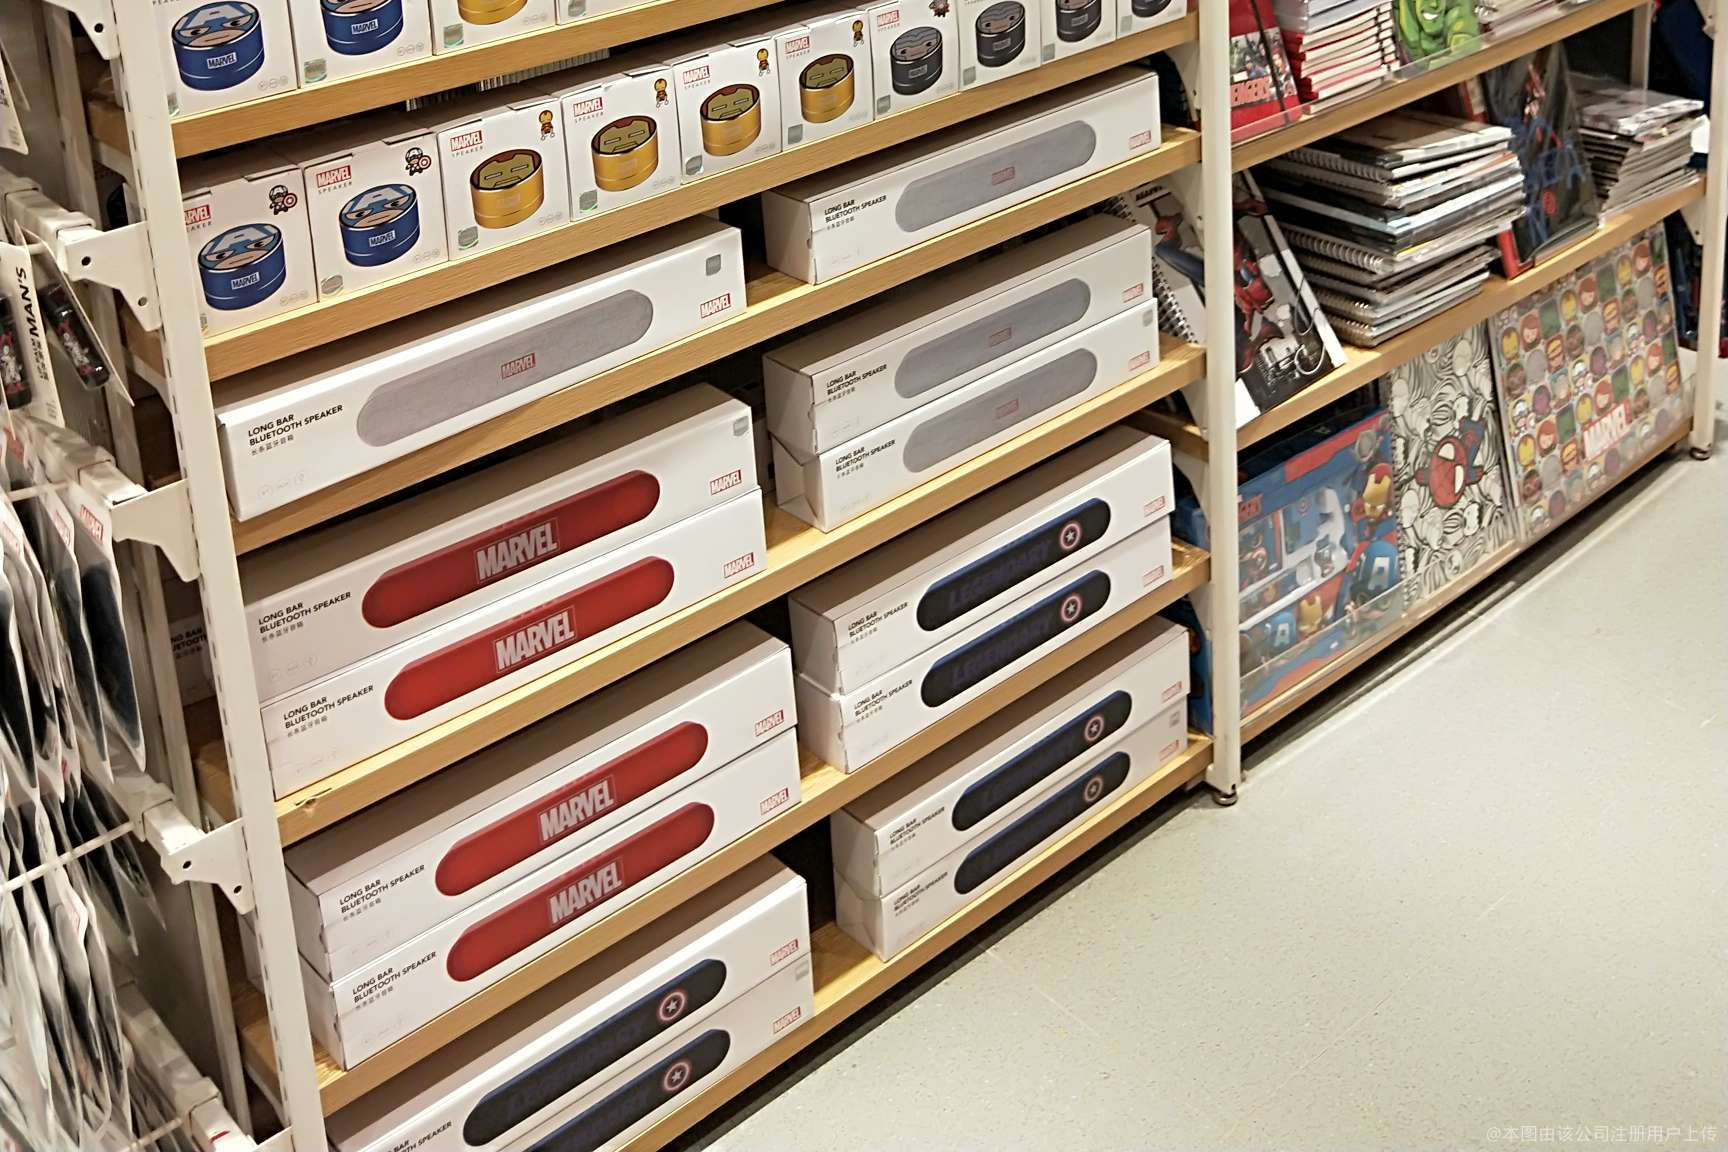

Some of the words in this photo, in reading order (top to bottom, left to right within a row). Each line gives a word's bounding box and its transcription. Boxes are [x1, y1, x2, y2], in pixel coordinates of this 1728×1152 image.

[352, 19, 378, 34] MARVEL
[784, 36, 810, 54] MARVEL
[207, 52, 237, 69] MARVEL
[683, 65, 710, 84] MARVEL
[573, 96, 602, 117] MARVEL
[451, 130, 483, 151] MARVEL
[452, 146, 484, 157] SPEAKER
[316, 165, 352, 188] MARVEL
[317, 182, 353, 194] SPEAKER
[183, 204, 211, 225] ARVEL
[824, 203, 842, 216] LONG
[843, 199, 855, 209] BAR
[825, 205, 860, 223] BLUETOOTH
[861, 195, 887, 211] SPEAKER
[369, 231, 395, 247] MARVEL
[231, 271, 260, 290] MARVEL
[701, 293, 731, 318] MARVEL
[501, 352, 536, 379] MARVEL
[826, 374, 844, 388] LONG
[844, 370, 857, 380] BAR
[827, 376, 862, 396] BLUETOOTH
[862, 364, 887, 382] SPEAKER
[248, 419, 274, 437] LONG
[276, 414, 294, 428] BAR
[249, 420, 302, 446] BLUETOOTH
[304, 404, 343, 426] SPEAKER
[1583, 400, 1632, 461] MARVEL
[835, 451, 852, 465] LONG
[853, 446, 865, 457] BAR
[836, 452, 870, 472] BLUETOOTH
[870, 439, 895, 458] SPEAKER
[710, 470, 741, 495] MARVEL
[475, 521, 558, 581] MARVEL
[724, 552, 754, 578] MARVEL
[258, 608, 284, 625] LONG
[286, 602, 304, 614] BAR
[259, 608, 312, 634] BLUETOOTH
[313, 591, 351, 612] SPEAKER
[495, 610, 576, 670] MARVEL
[283, 704, 308, 721] LONG
[310, 696, 327, 708] BAR
[285, 702, 335, 729] BLUETOOTH
[337, 685, 374, 706] SPEAKER
[755, 709, 784, 736] MARVEL
[540, 779, 615, 841] MARVEL
[760, 788, 789, 815] MARVEL
[339, 886, 363, 905] LONG
[364, 879, 381, 892] BAR
[341, 885, 389, 914] BLUETOOTH
[390, 864, 425, 887] SPEAKER
[549, 858, 623, 924] MARVEL
[770, 938, 799, 966] MARVEL
[352, 975, 376, 995] LONG
[377, 967, 394, 981] BAR
[354, 973, 401, 1003] BLUETOOTH
[402, 951, 437, 975] SPEAKER
[773, 1007, 801, 1034] MARVEL
[418, 1121, 452, 1146] SPEAKER
